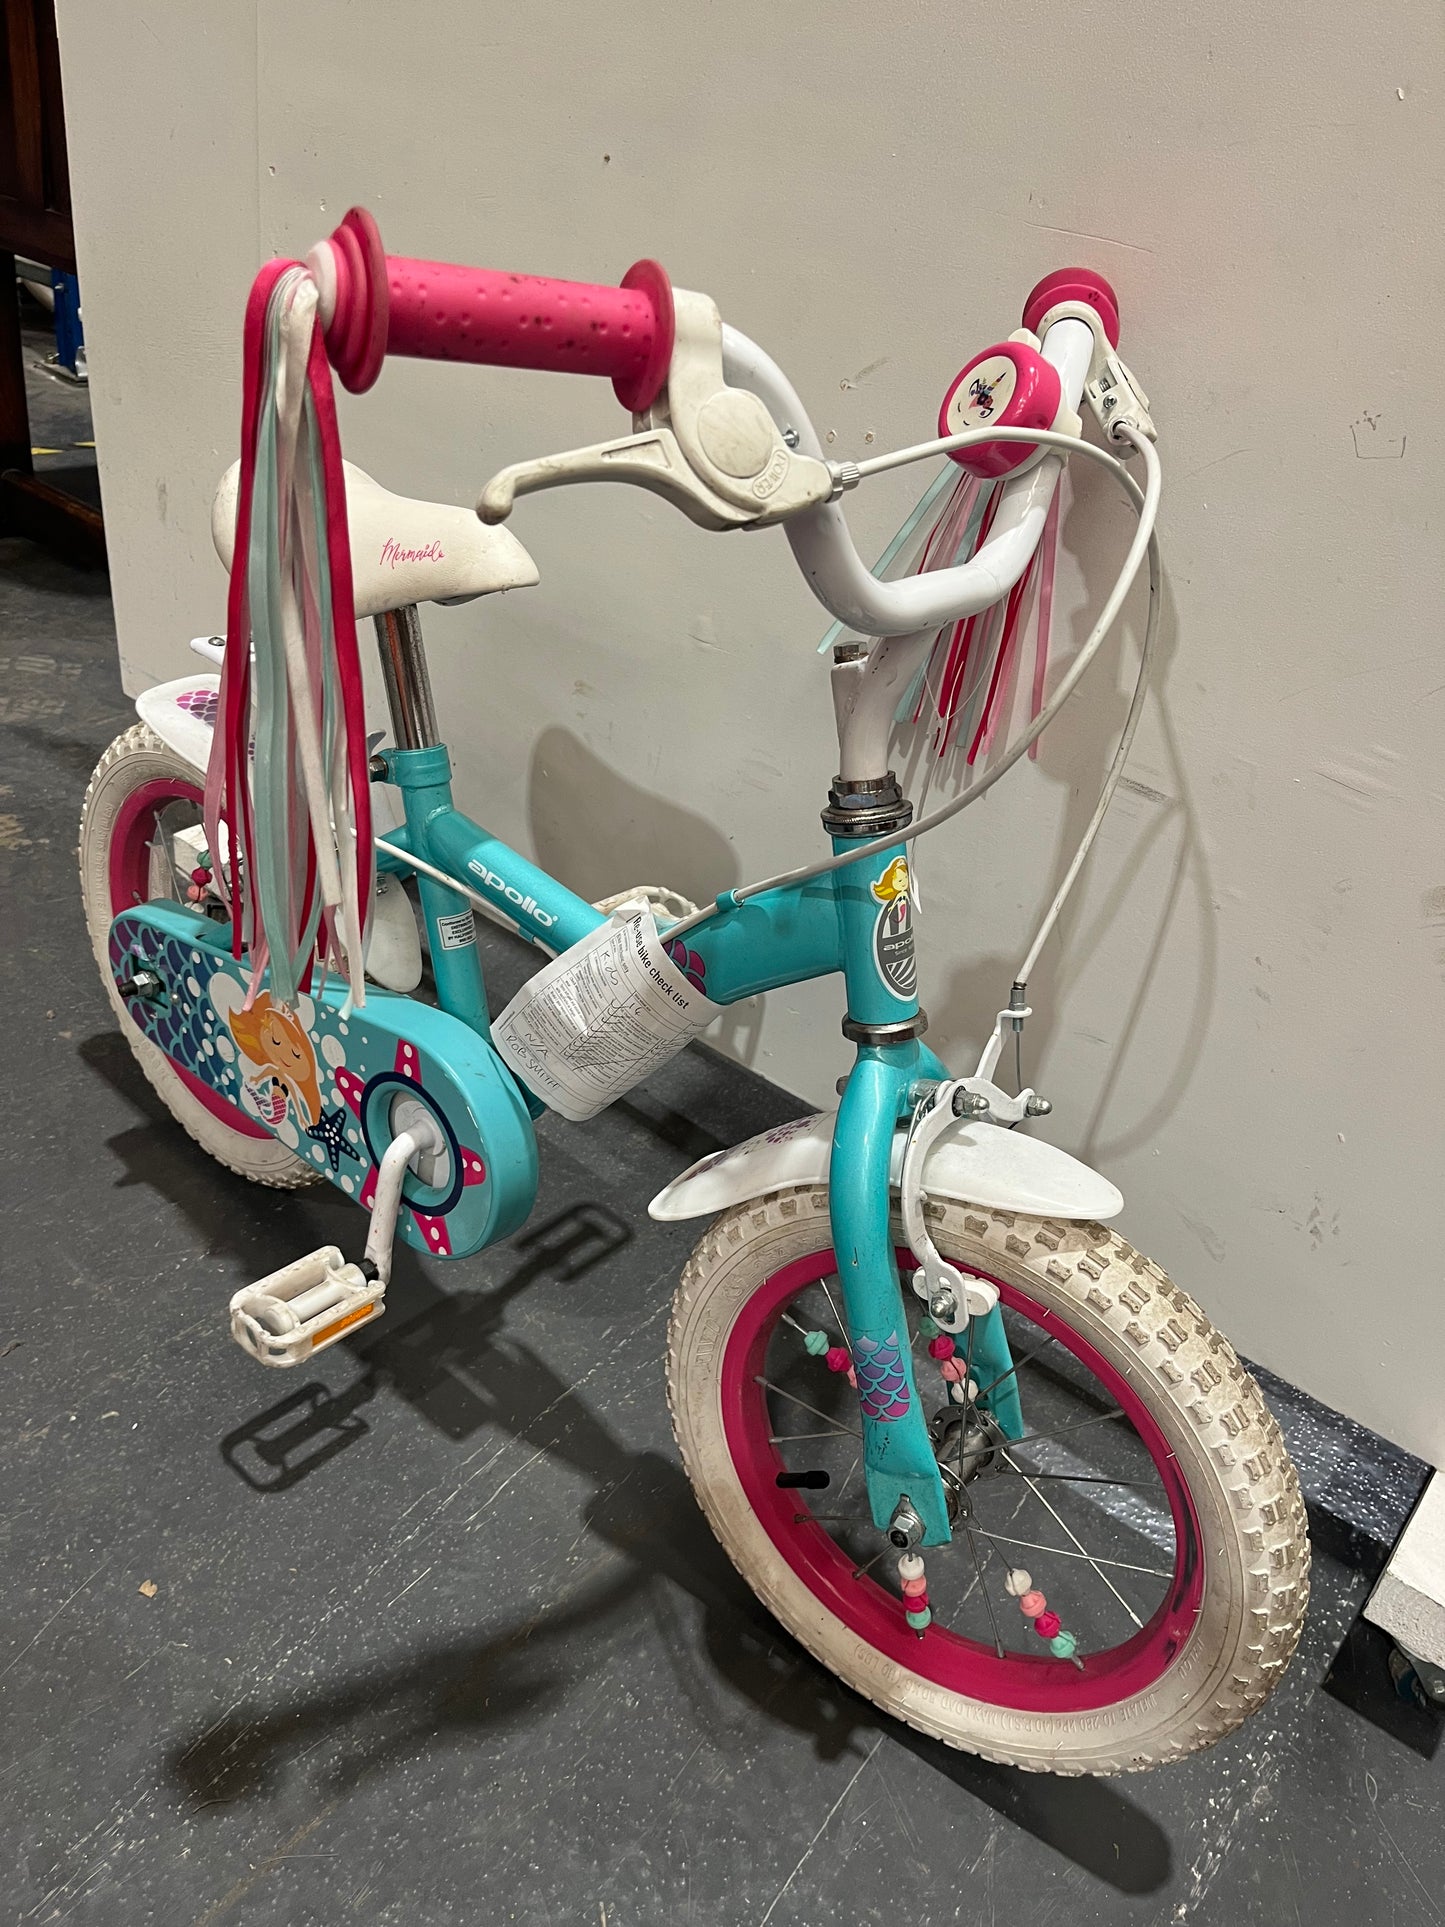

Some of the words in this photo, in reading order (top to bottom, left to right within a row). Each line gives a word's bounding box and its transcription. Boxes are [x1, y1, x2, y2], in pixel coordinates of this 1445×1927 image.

[468, 859, 553, 927] apollo
[637, 946, 652, 968] bike
[649, 963, 674, 995] check
[672, 992, 690, 1010] list
